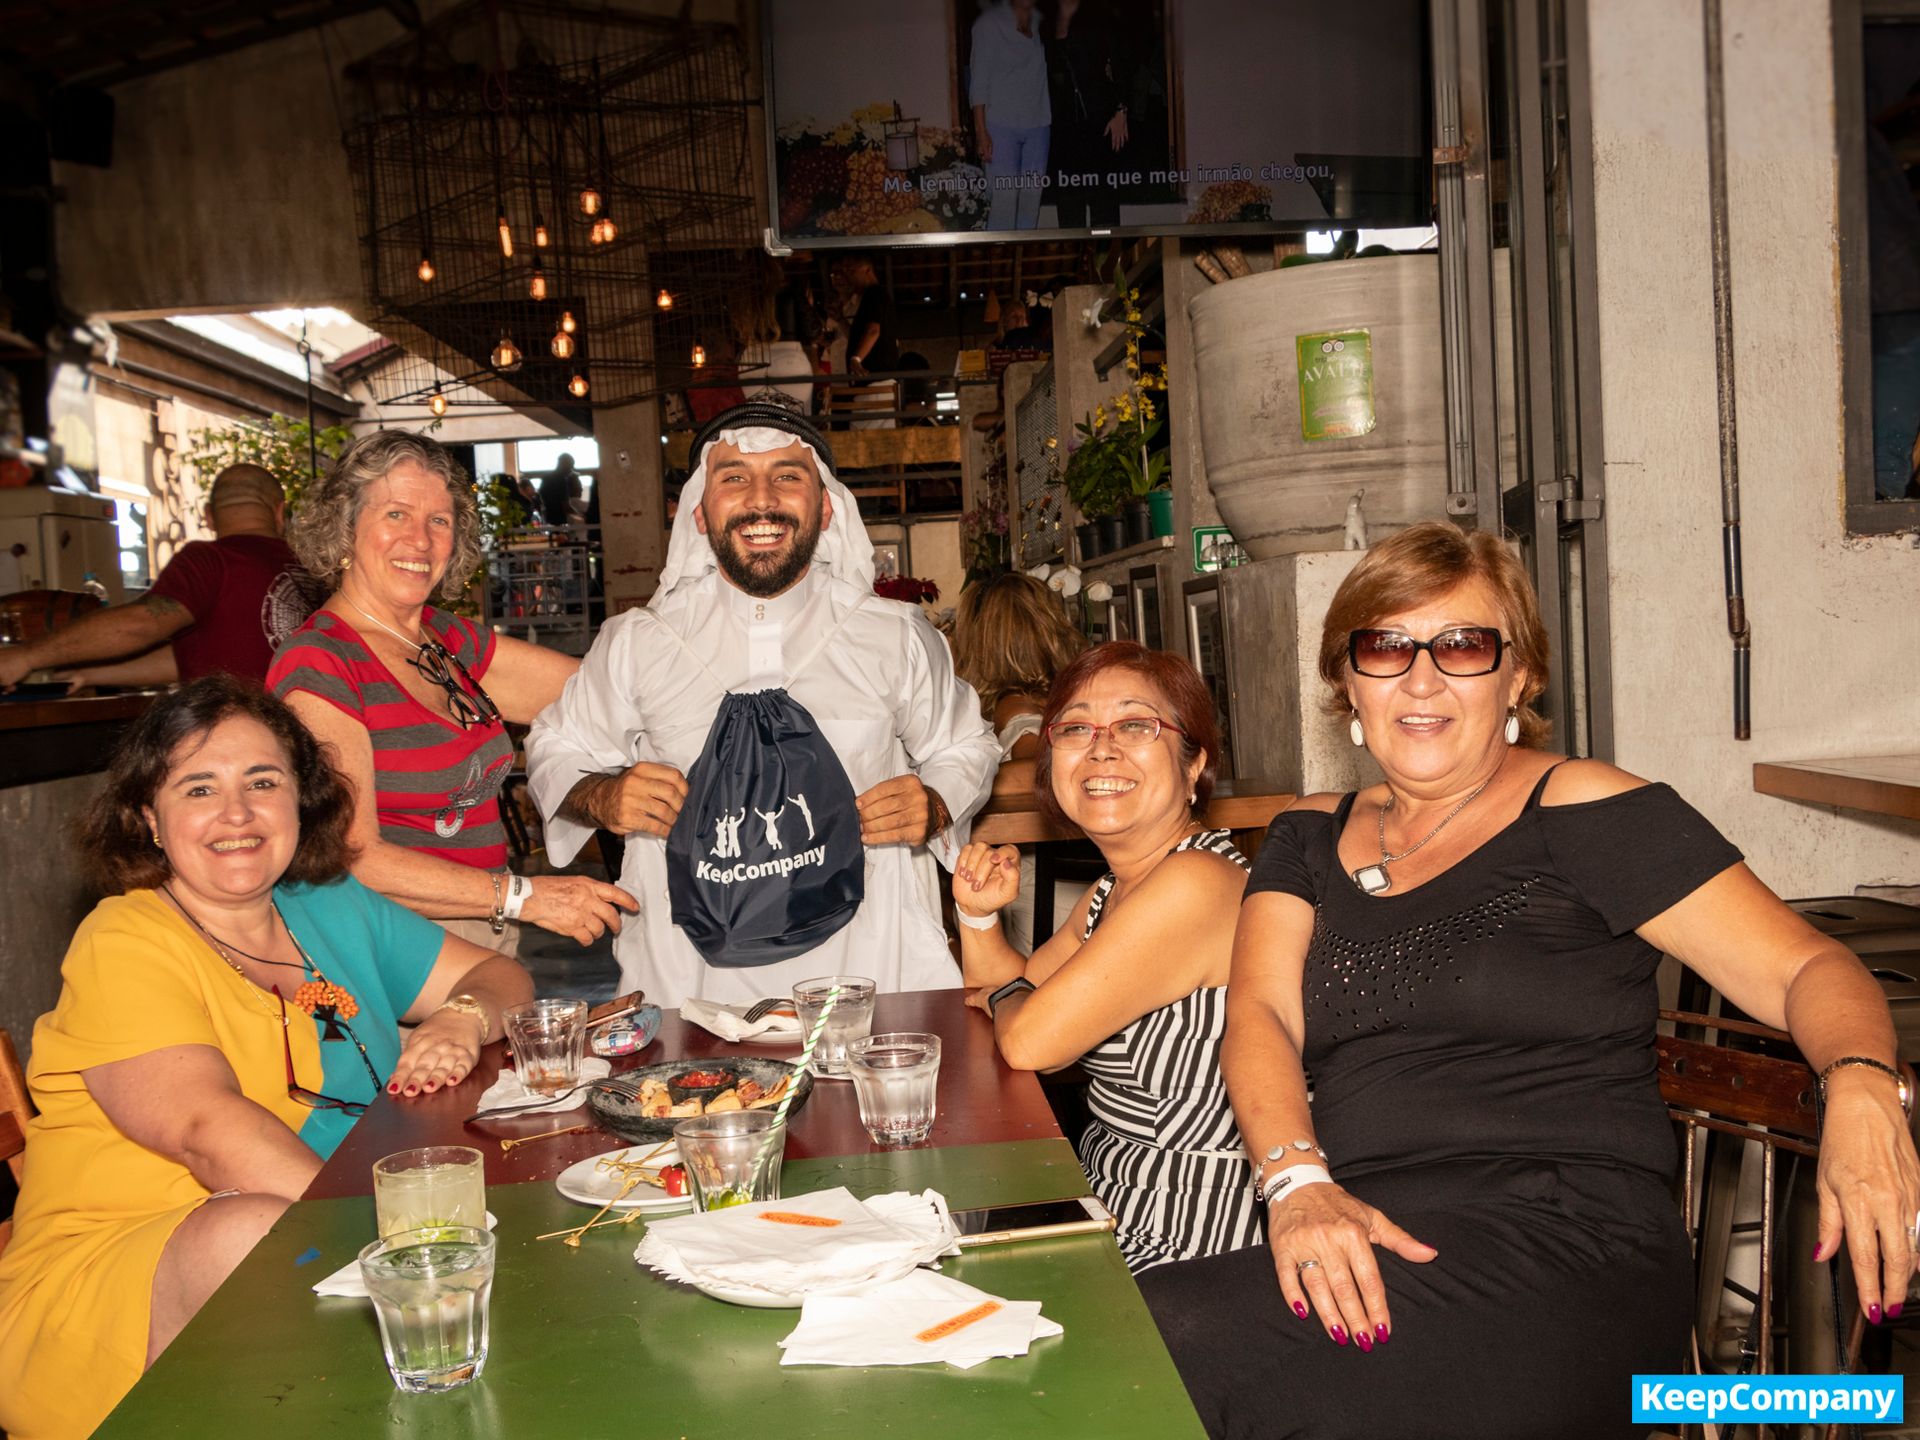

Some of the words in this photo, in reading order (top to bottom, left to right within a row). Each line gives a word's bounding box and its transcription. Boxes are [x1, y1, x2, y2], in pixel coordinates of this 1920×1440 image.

[884, 178, 912, 194] Me
[920, 174, 987, 192] lembro
[995, 169, 1050, 189] muito
[1058, 169, 1099, 187] bem
[1107, 171, 1142, 189] que
[1149, 170, 1191, 184] meu
[1197, 163, 1252, 182] irmão
[1261, 162, 1335, 183] chegou,
